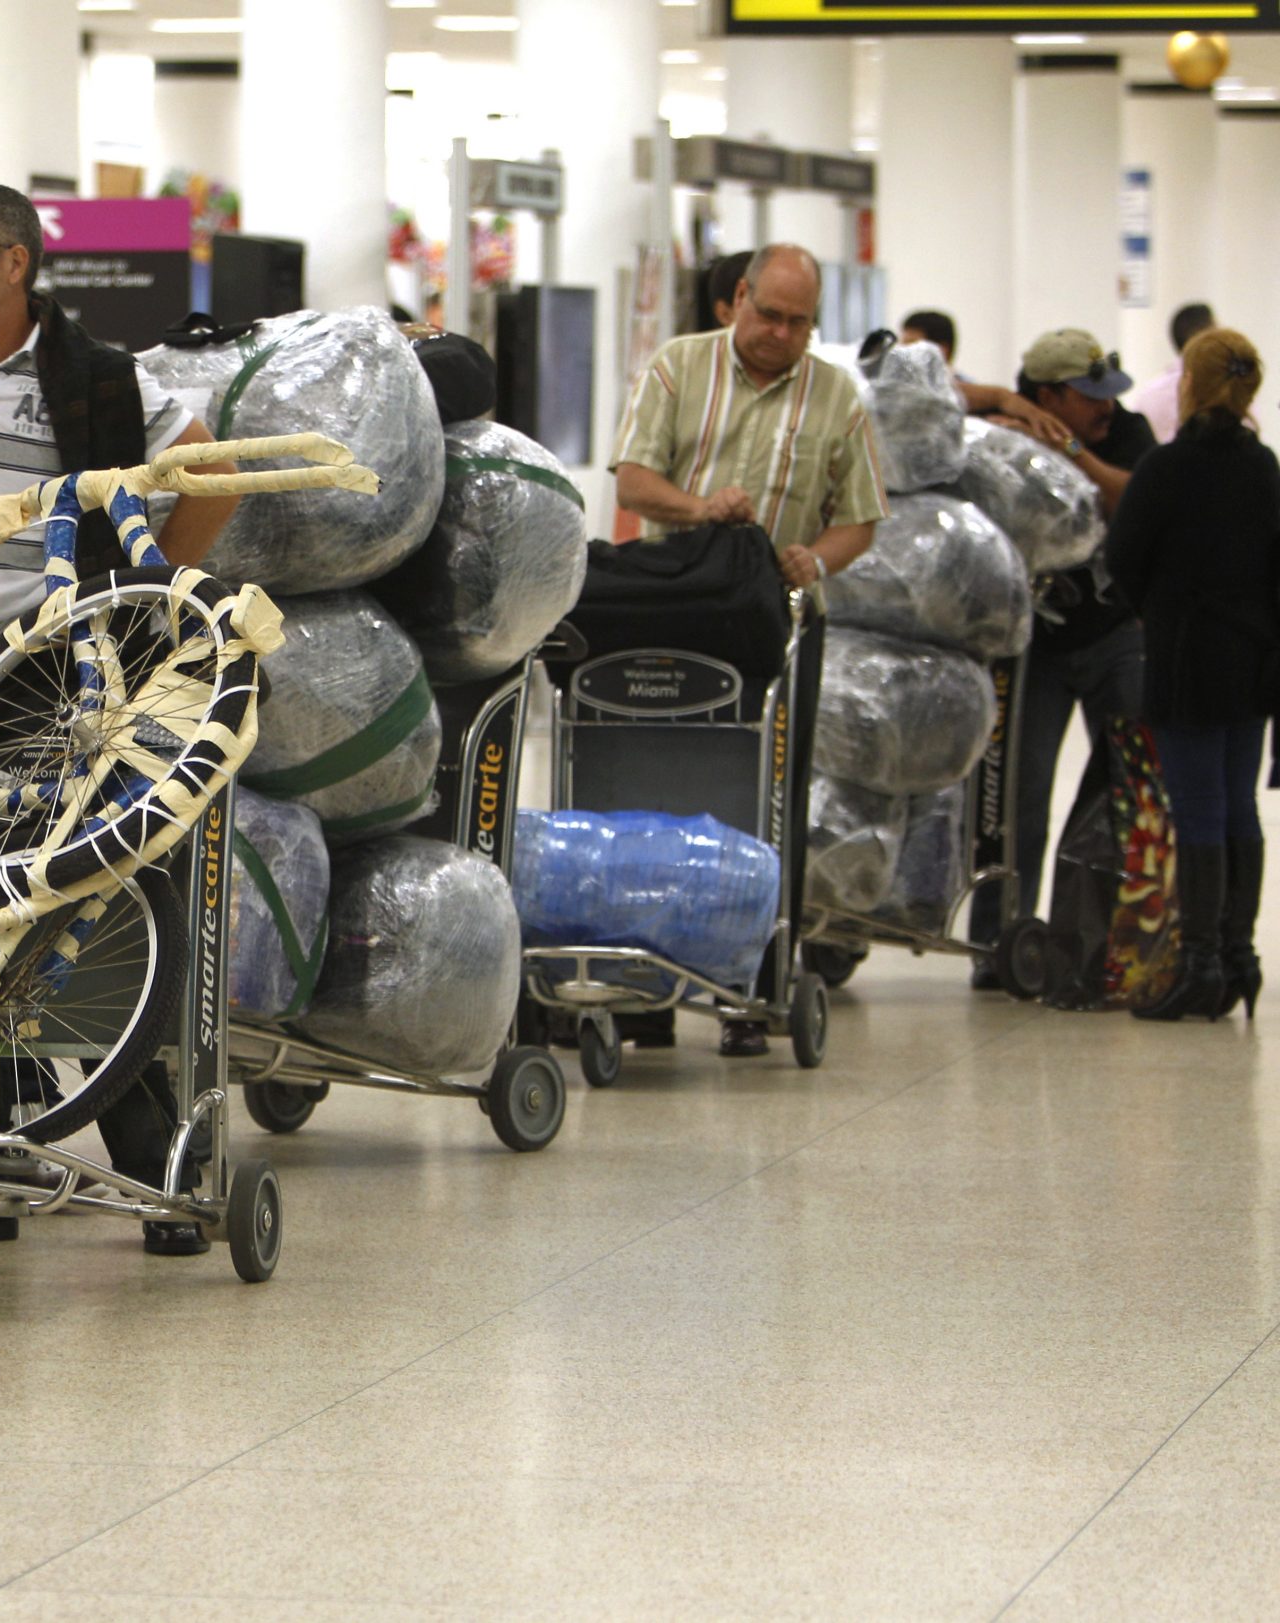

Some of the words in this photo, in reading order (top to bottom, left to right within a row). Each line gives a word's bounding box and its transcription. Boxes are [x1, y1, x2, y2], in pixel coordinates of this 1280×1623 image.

[628, 682, 680, 697] Miami
[8, 764, 67, 779] Welcom
[200, 806, 222, 1051] smartecarte
